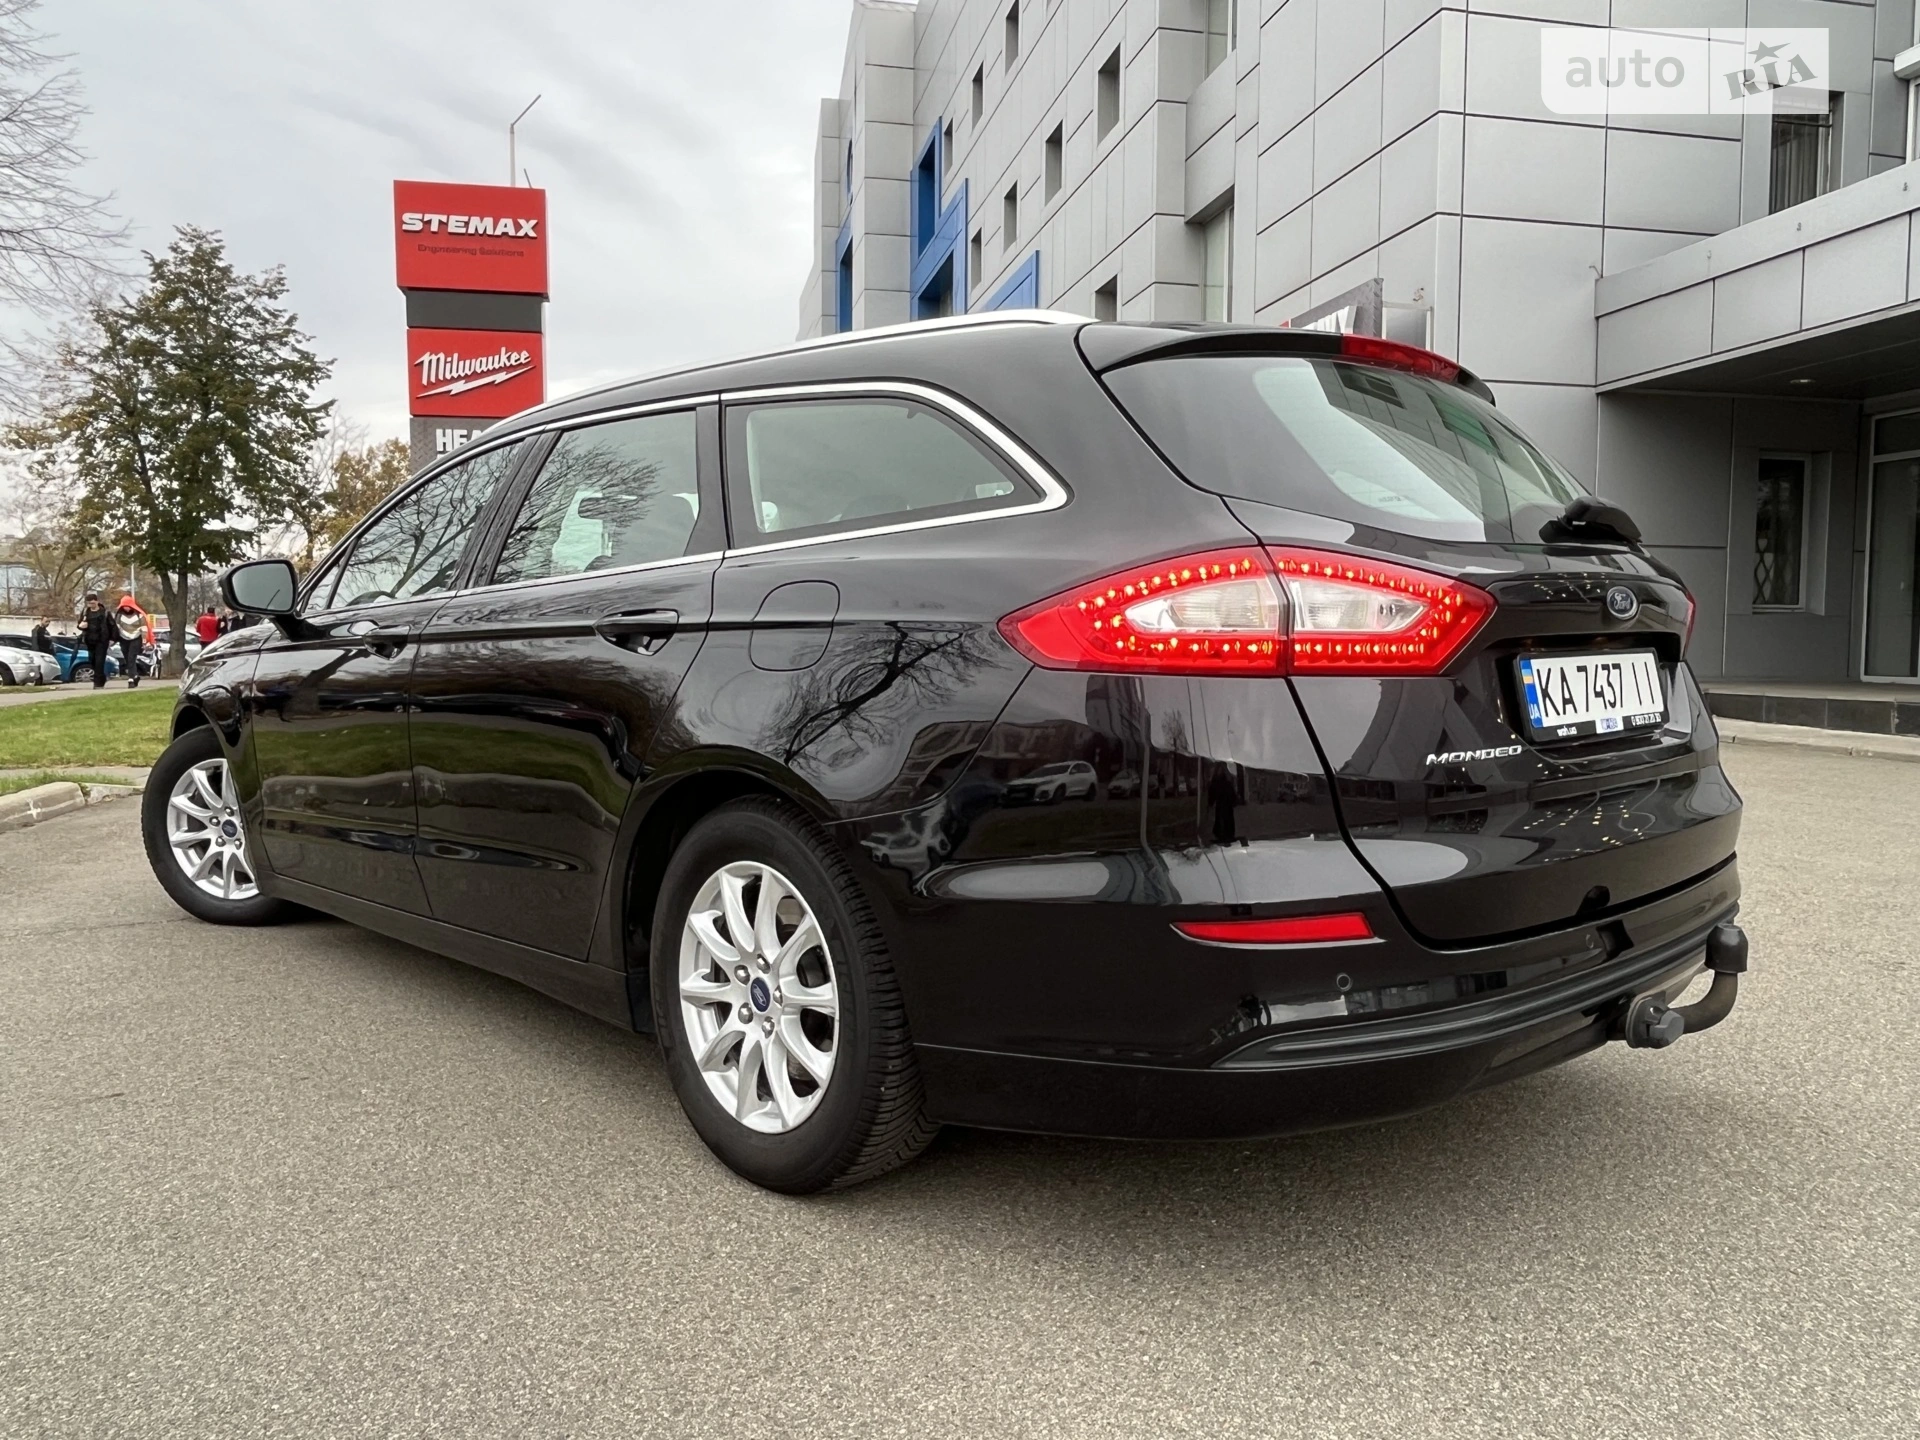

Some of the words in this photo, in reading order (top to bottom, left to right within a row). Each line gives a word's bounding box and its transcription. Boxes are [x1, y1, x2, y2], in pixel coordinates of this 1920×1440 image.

[401, 212, 538, 238] STEMAX
[417, 243, 477, 256] Engineering
[479, 247, 525, 257] Solutions
[413, 346, 532, 386] Milwaukee
[1536, 667, 1578, 718] KA
[1575, 662, 1624, 712] 7437
[1529, 703, 1541, 719] UA
[1426, 744, 1523, 766] MONDEO
